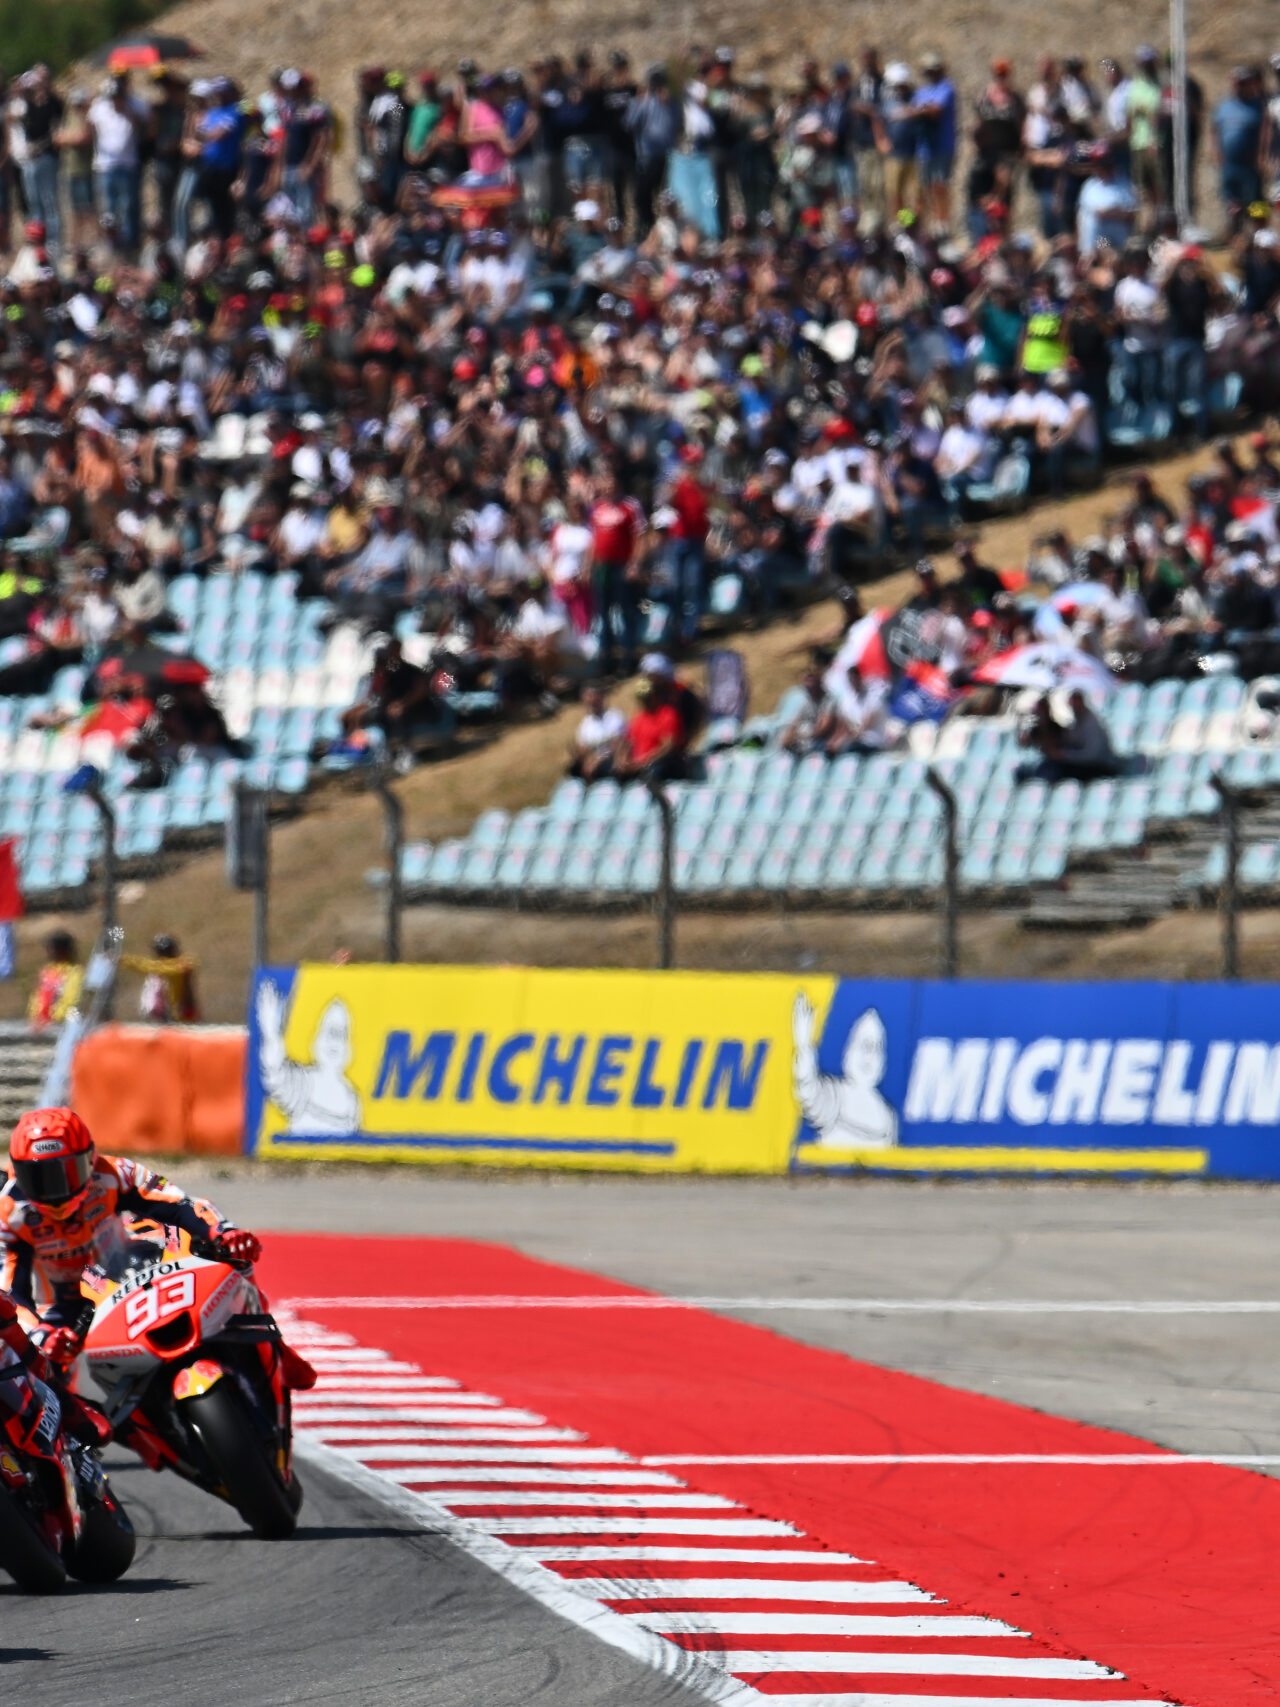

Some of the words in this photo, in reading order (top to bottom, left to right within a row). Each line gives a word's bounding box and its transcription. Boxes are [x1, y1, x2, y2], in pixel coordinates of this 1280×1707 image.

[371, 1030, 770, 1111] MICHELIN
[903, 1036, 1280, 1127] MICHELIN
[112, 1261, 184, 1303] REPSOL
[126, 1272, 195, 1340] 93
[202, 1270, 241, 1319] HONDA
[89, 1347, 144, 1360] HONDA
